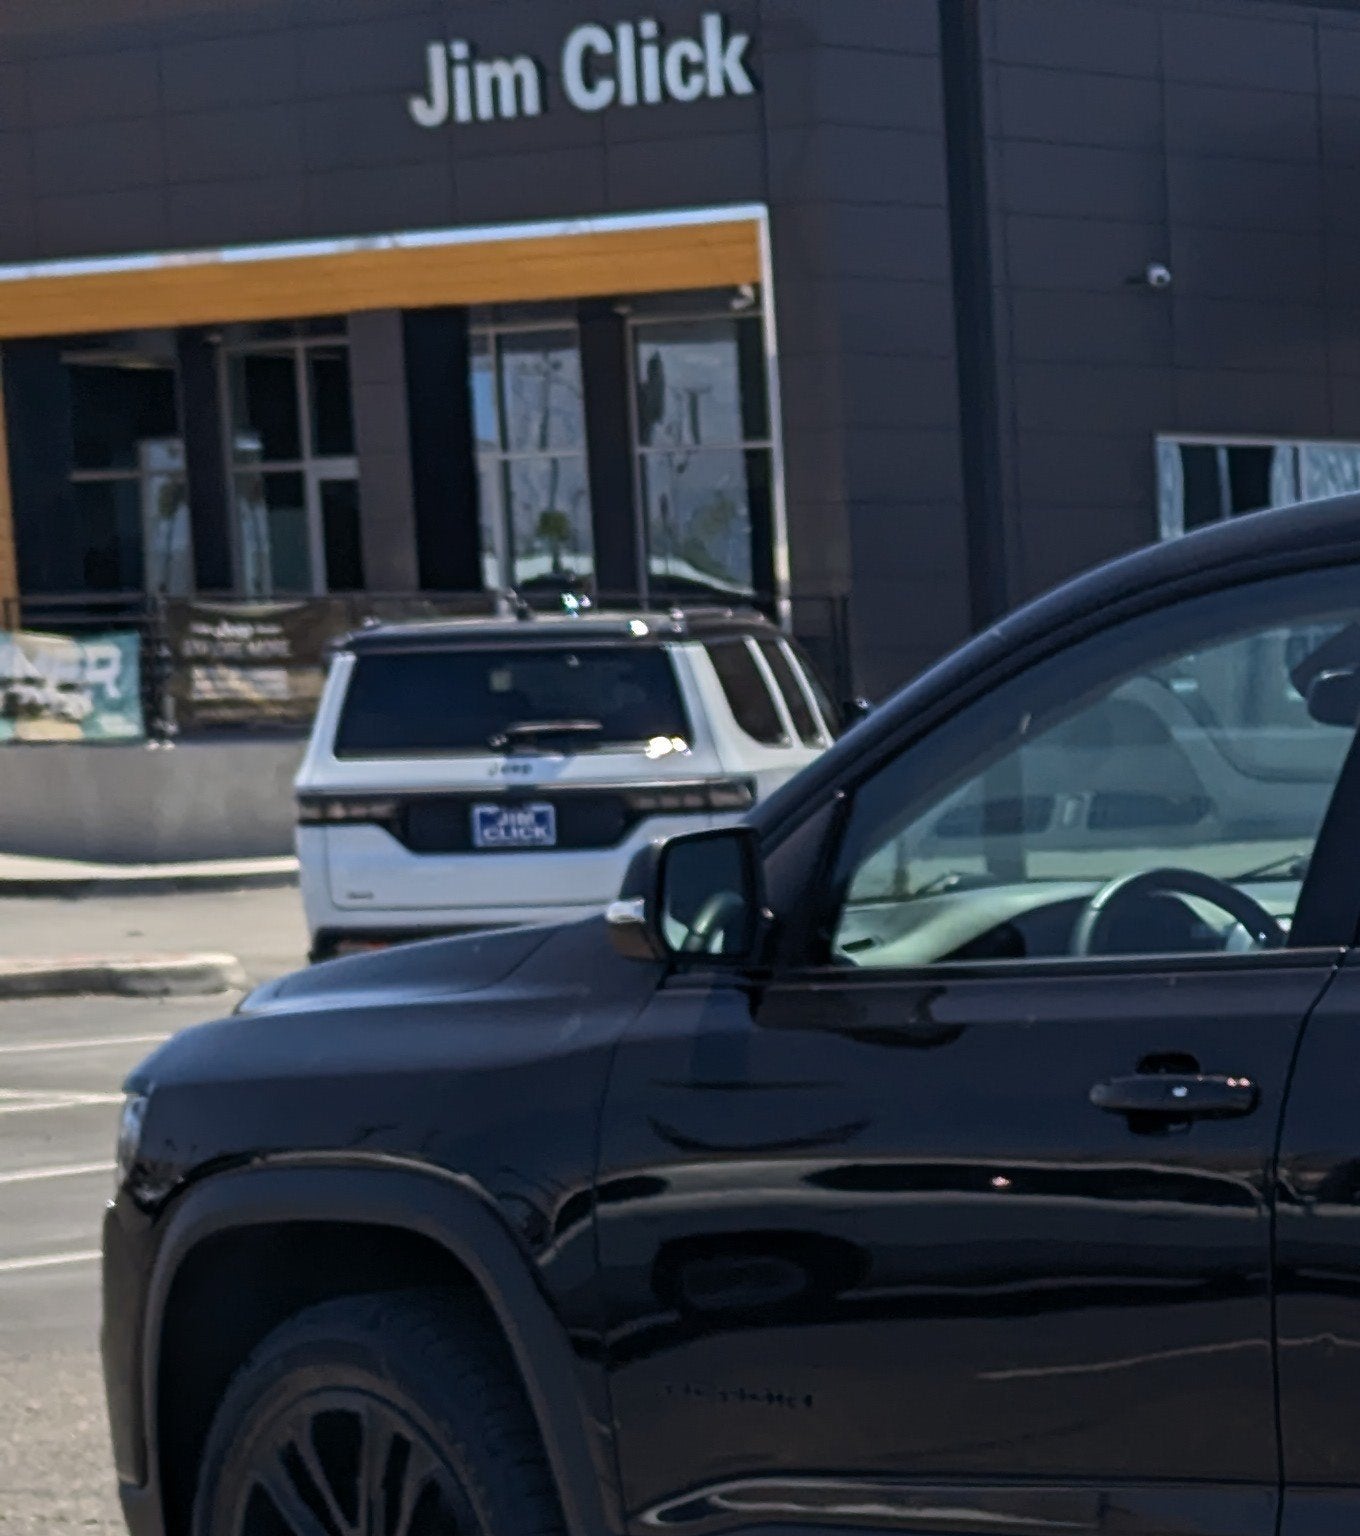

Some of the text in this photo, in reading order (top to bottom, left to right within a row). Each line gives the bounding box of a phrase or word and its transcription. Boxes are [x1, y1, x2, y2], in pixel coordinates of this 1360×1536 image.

[407, 12, 756, 127] Jim Click
[497, 811, 536, 826] JIM
[483, 824, 548, 840] CLICK
